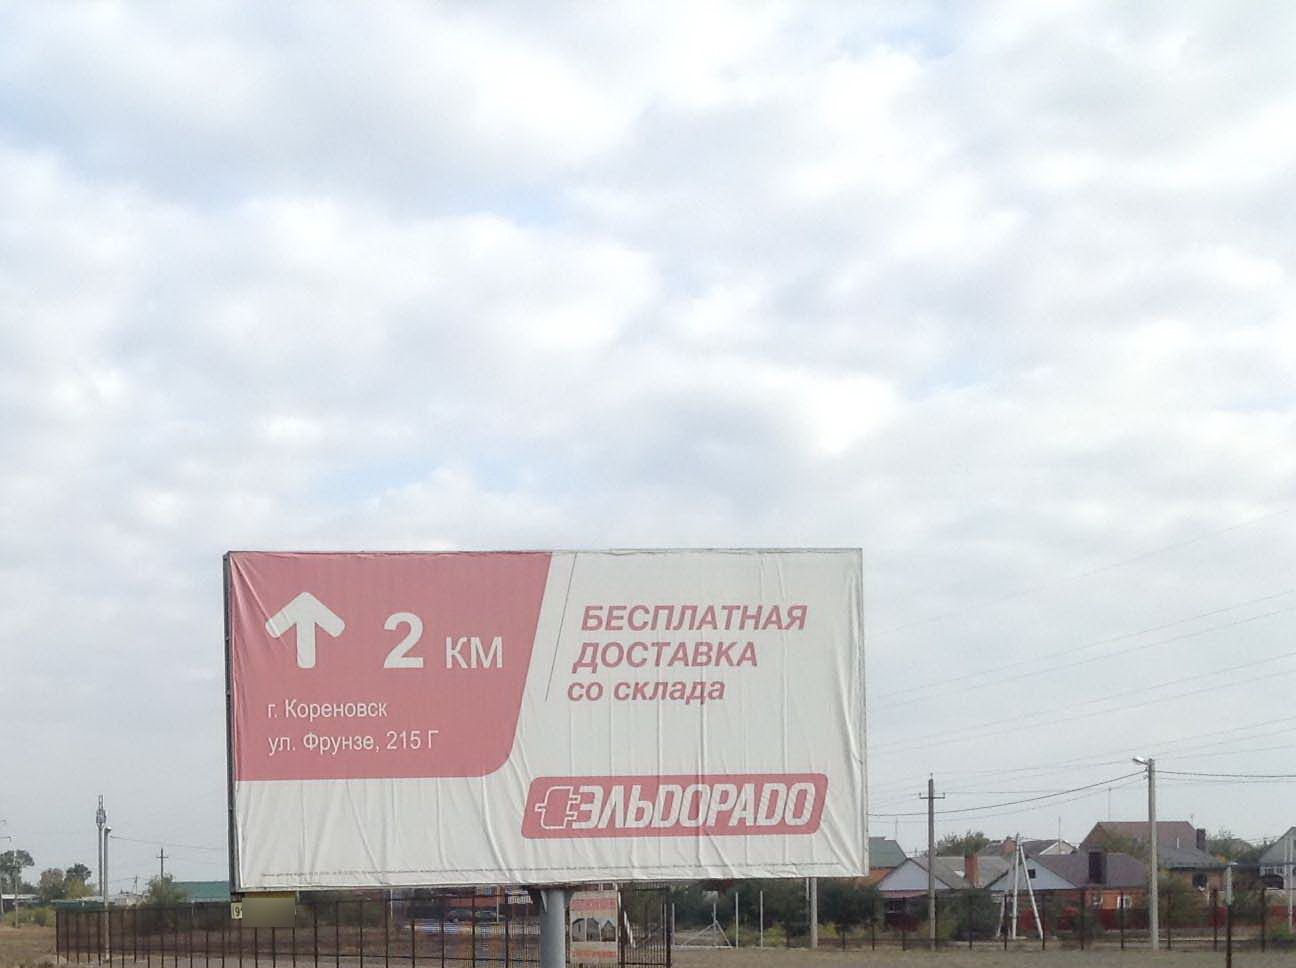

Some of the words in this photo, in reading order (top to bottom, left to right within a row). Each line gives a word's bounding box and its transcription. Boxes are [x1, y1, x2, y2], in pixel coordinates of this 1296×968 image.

[581, 604, 807, 631] БЕСПЛАТНАЯ
[383, 611, 424, 669] 2
[571, 641, 758, 674] ДОСТАВКА
[567, 681, 604, 701] со
[613, 680, 726, 705] склада
[267, 702, 278, 718] г.
[285, 699, 388, 721] Кореновск
[268, 735, 296, 756] ул.
[303, 731, 380, 755] Фрунзе,
[386, 730, 421, 750] 215
[428, 730, 439, 749] Г
